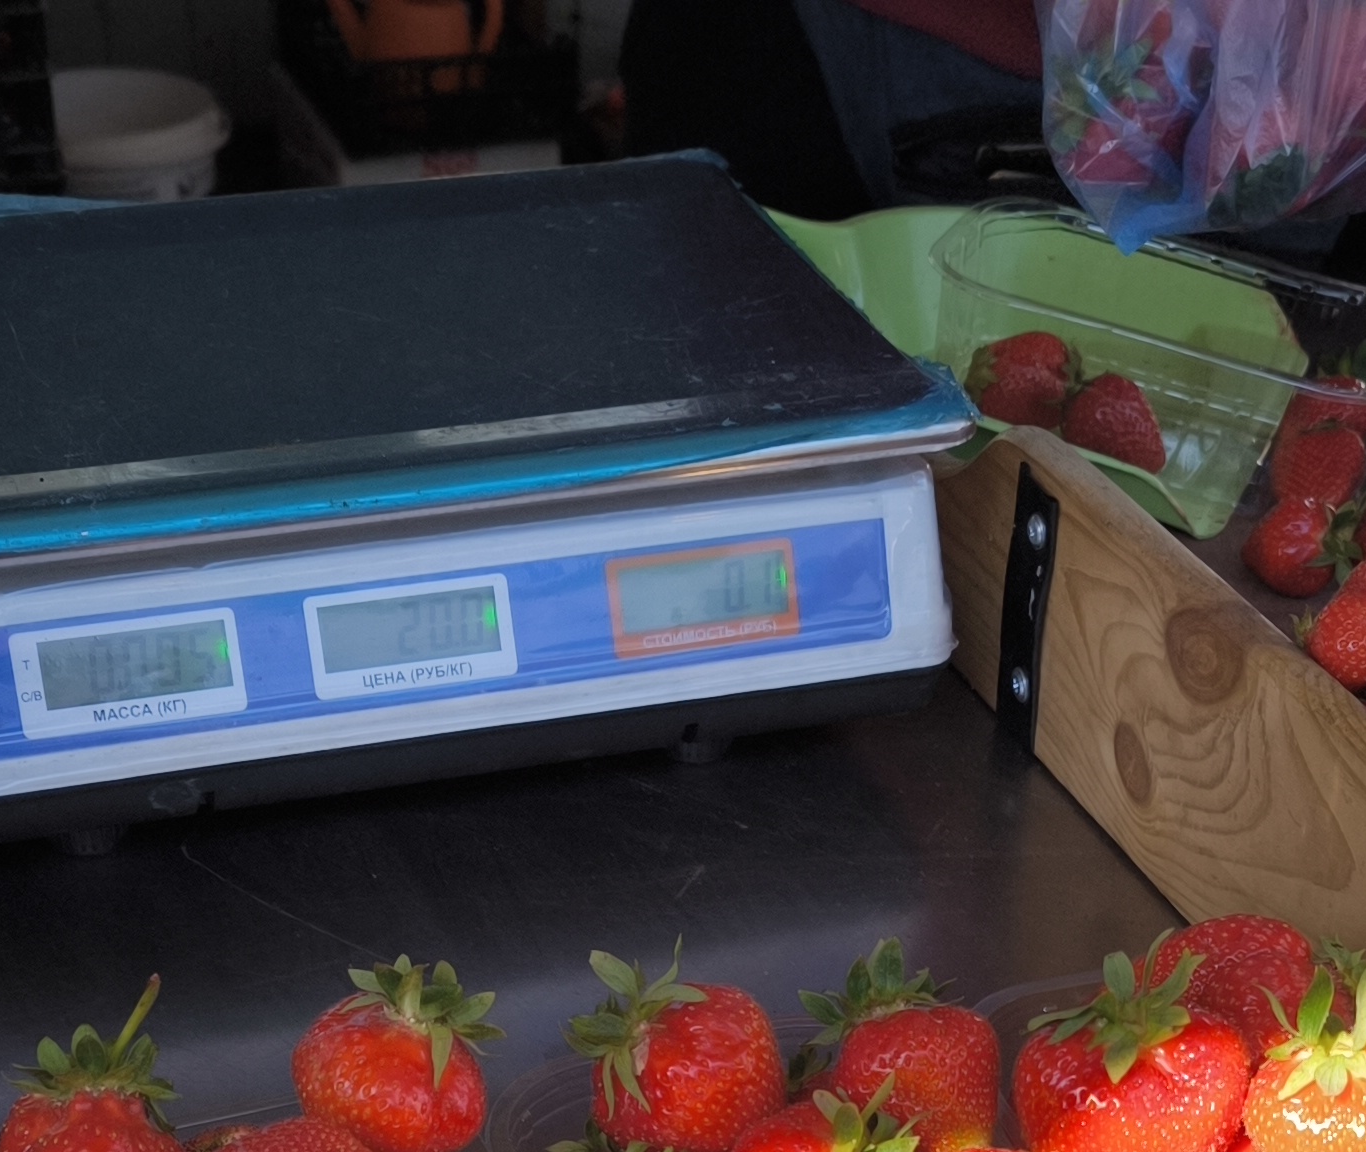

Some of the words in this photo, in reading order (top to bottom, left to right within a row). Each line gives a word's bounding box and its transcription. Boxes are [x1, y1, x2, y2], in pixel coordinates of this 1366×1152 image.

[643, 625, 736, 648] СТОИМОСТЬ
[739, 619, 778, 637] (РУБ)
[362, 671, 406, 689] ЦЕНА
[411, 661, 474, 684] (РУБ/КГ)
[93, 703, 153, 723] МАССА
[158, 699, 188, 718] (КГ)
